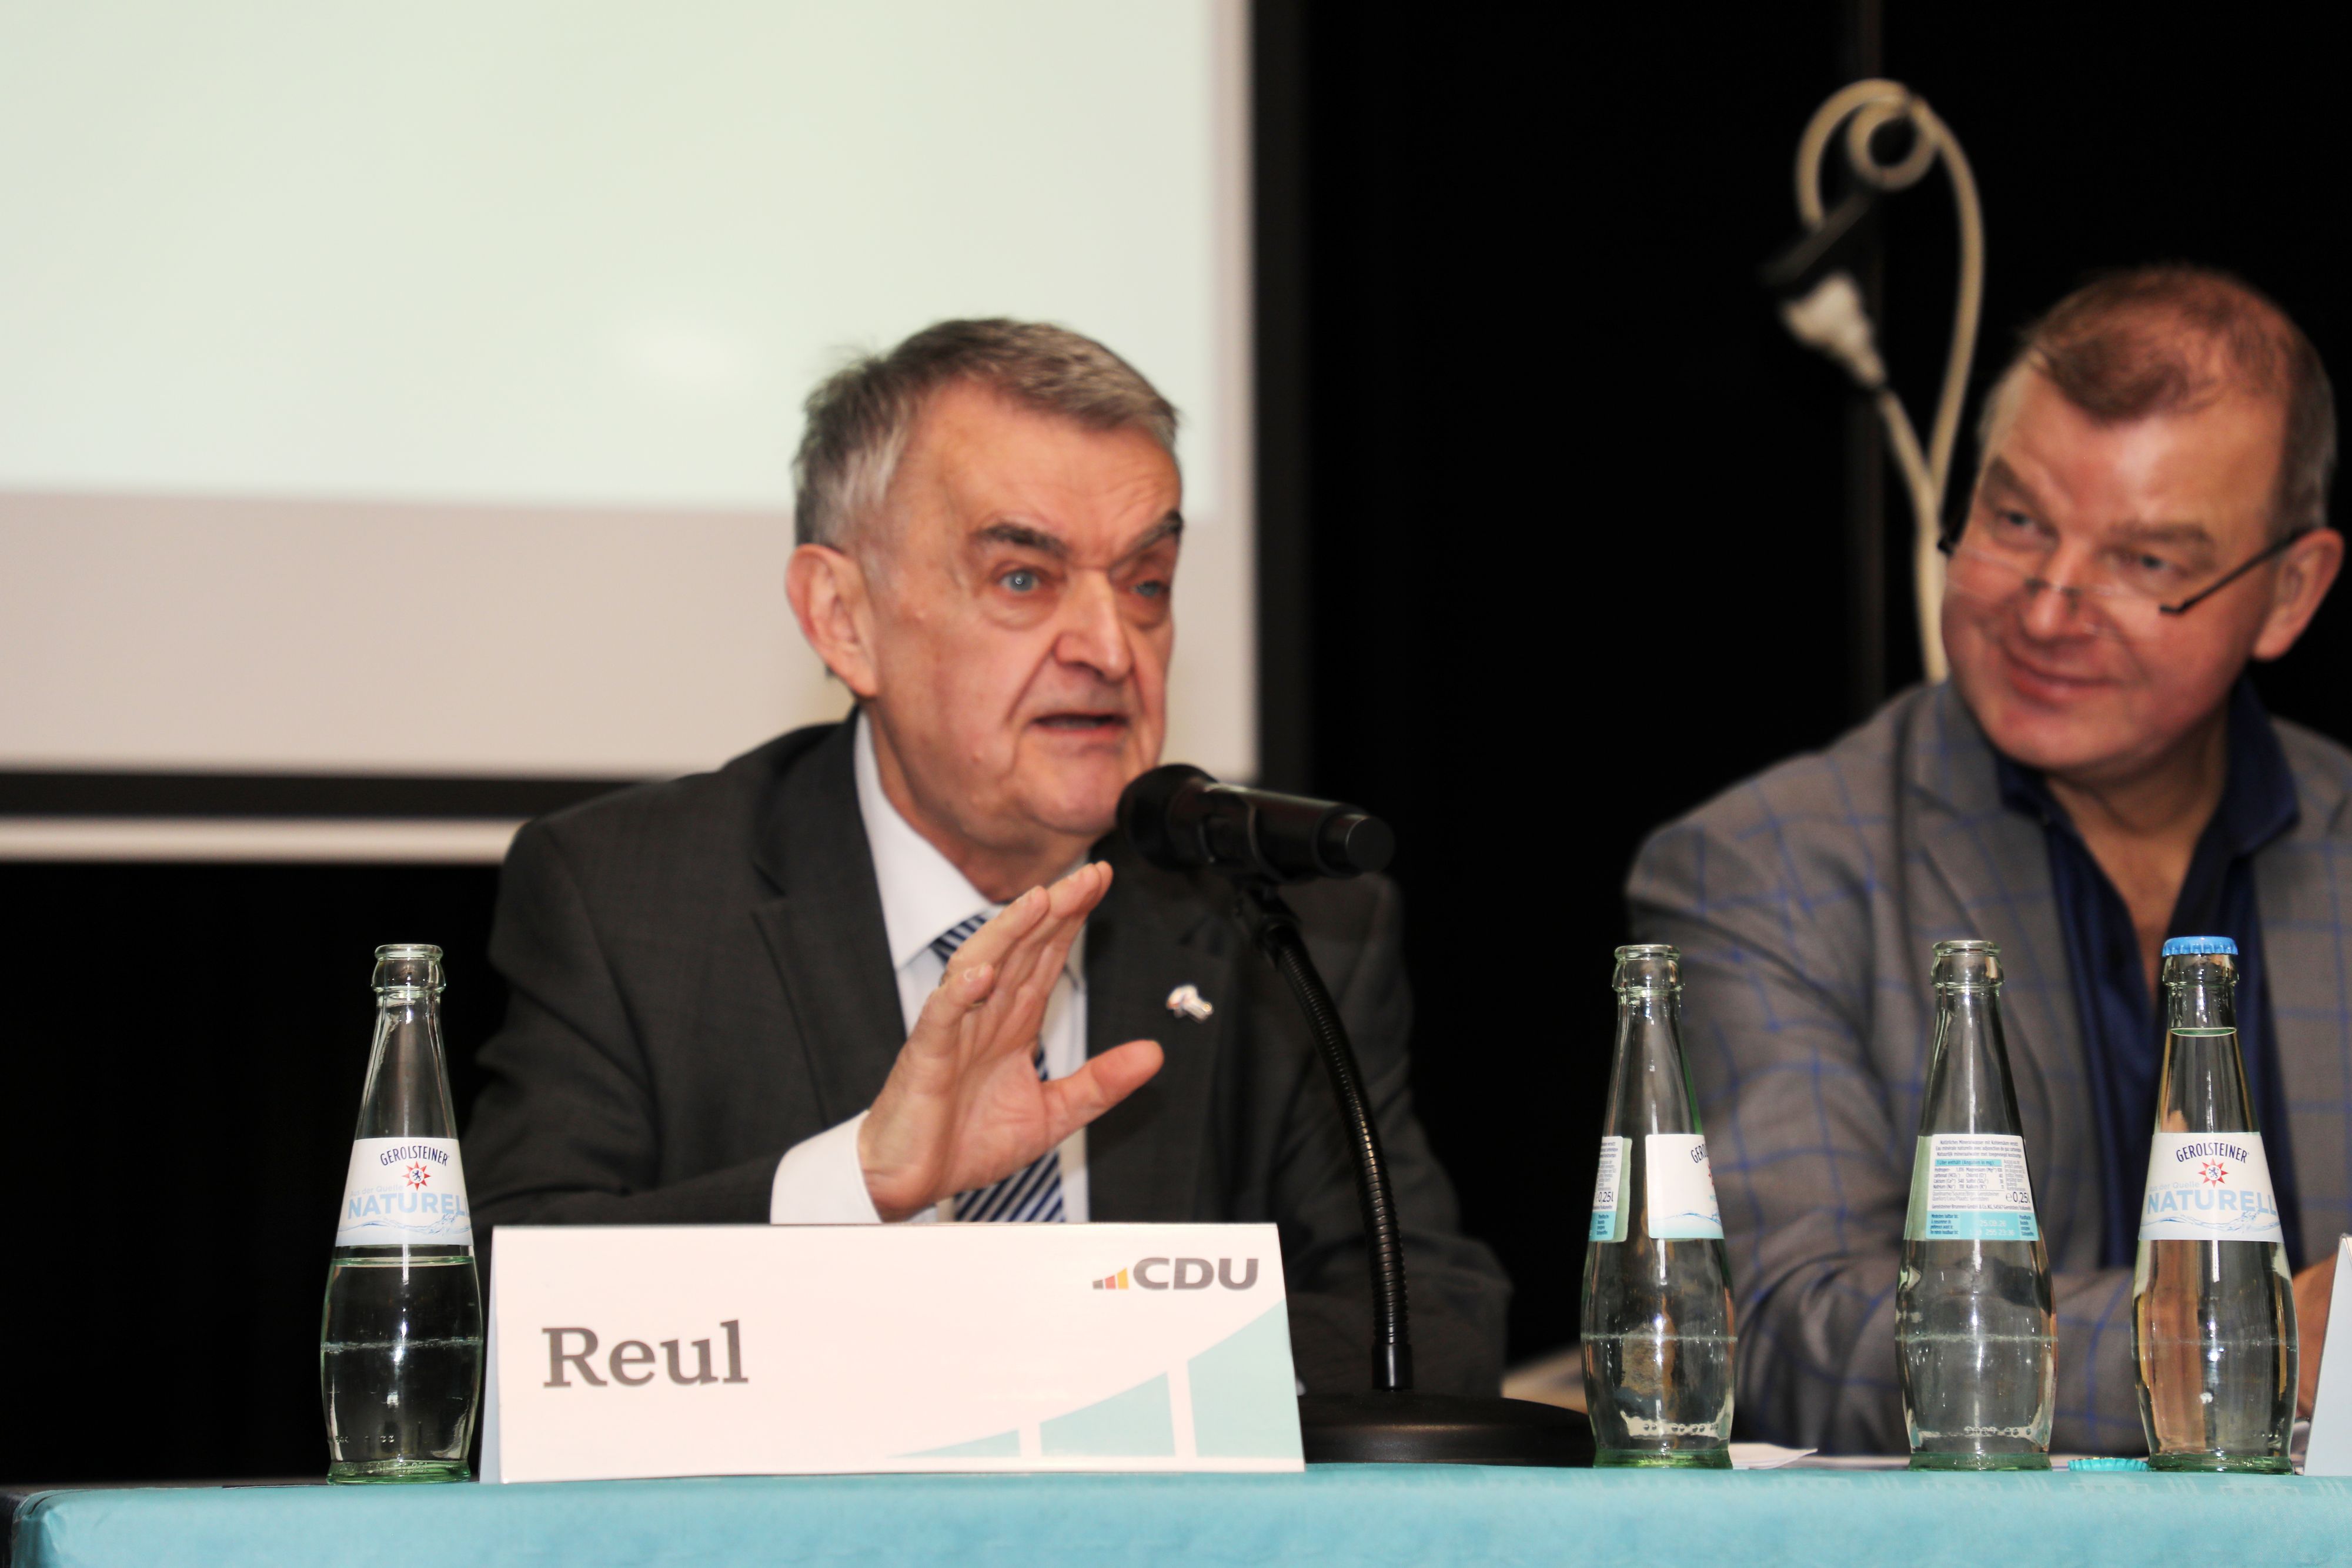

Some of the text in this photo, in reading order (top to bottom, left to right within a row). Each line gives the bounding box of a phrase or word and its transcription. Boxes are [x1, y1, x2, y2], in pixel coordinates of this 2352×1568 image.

[380, 1145, 449, 1166] GEROLSTEINER
[2176, 1142, 2248, 1163] GEROLSTEINER
[376, 1184, 404, 1193] Quelle
[2147, 1189, 2277, 1216] NATURELL
[1132, 1256, 1259, 1291] CDU
[541, 1319, 749, 1388] Reul
